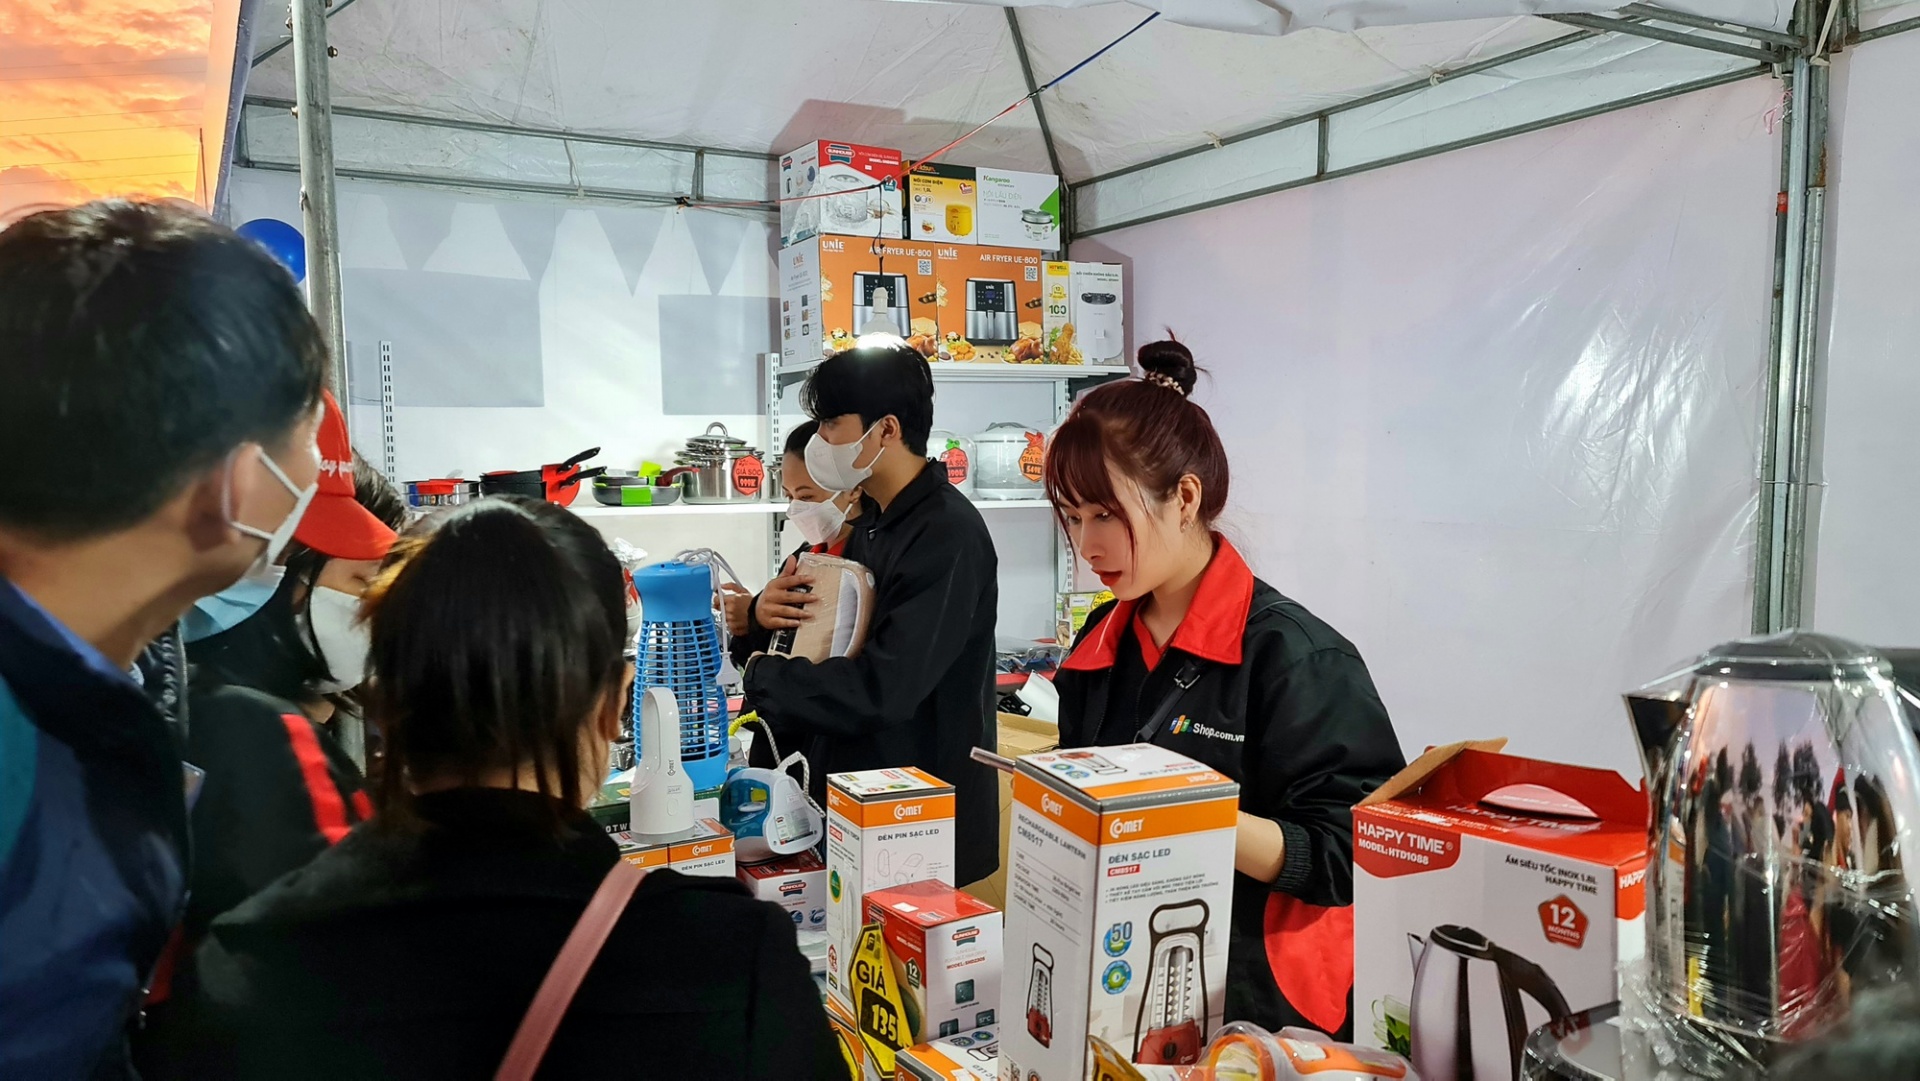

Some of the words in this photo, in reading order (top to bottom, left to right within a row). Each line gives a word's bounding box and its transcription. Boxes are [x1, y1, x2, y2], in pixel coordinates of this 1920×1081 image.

[983, 175, 1010, 183] Kangaroo
[882, 247, 904, 255] FRYER
[905, 248, 931, 257] UE-800
[993, 255, 1012, 263] FRYER
[1014, 256, 1037, 264] UE-800
[1049, 305, 1066, 314] 100
[894, 804, 923, 820] COMET
[1041, 792, 1063, 817] COMET
[1109, 817, 1145, 839] COMET
[1357, 821, 1405, 843] HAPPY
[1407, 833, 1445, 855] TIME
[692, 844, 713, 856] COMET
[1153, 848, 1171, 858] LED
[1545, 875, 1574, 889] HAPPY
[1577, 882, 1597, 895] TIME
[1550, 904, 1576, 929] 12
[1112, 921, 1132, 942] 50
[1548, 925, 1580, 939] MONTHS
[856, 960, 886, 996] GIÁ
[907, 962, 918, 978] 12
